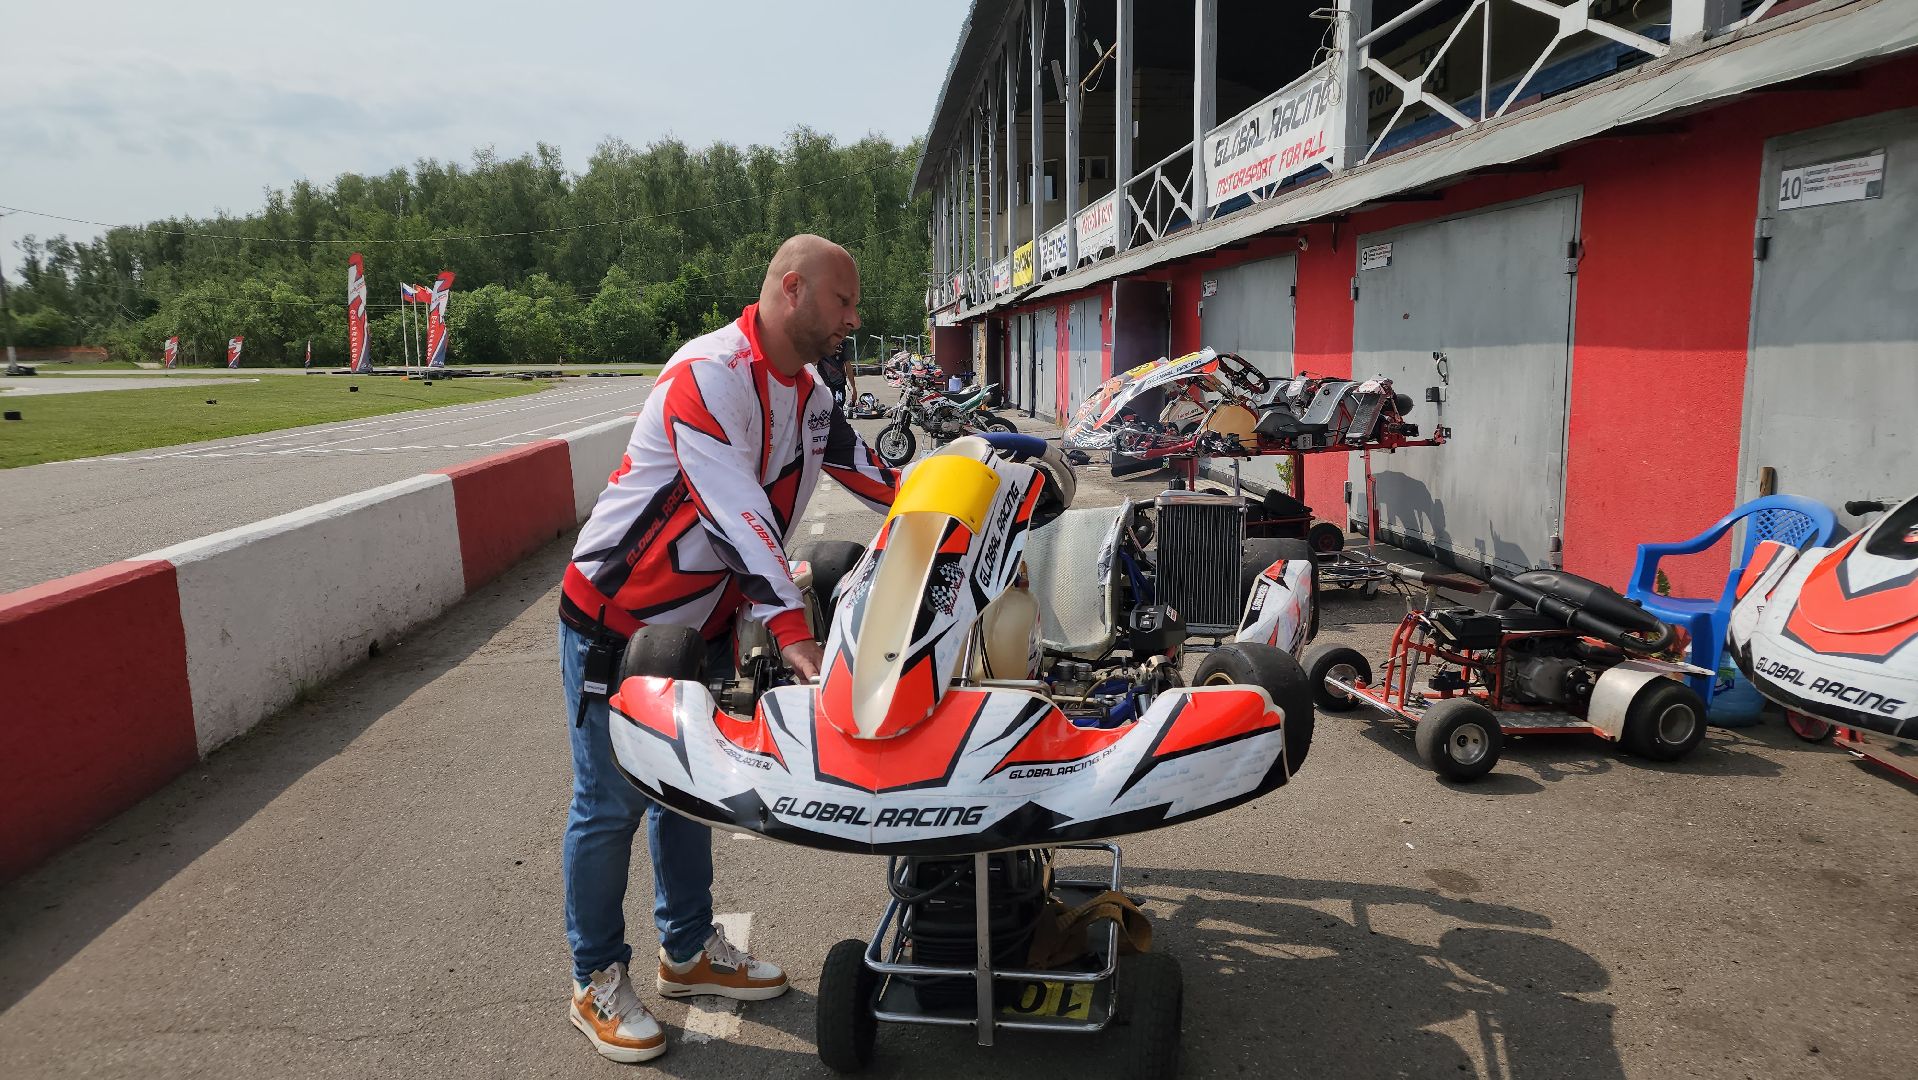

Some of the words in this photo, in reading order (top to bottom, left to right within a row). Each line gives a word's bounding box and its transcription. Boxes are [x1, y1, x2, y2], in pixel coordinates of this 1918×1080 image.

[1214, 117, 1266, 168] GLOBAL
[1268, 77, 1334, 142] RACING
[1216, 154, 1277, 197] MOTORSPORT
[1279, 142, 1302, 172] FOR
[1303, 131, 1327, 160] ALL
[1780, 176, 1802, 201] 10
[1362, 250, 1368, 265] 9
[625, 517, 667, 568] GLOBAL
[741, 511, 778, 553] GLOBAL
[980, 532, 1001, 588] GLOBAL
[996, 481, 1020, 536] RACING
[1755, 656, 1805, 687] GLOBAL
[1808, 676, 1907, 715] RACING
[771, 796, 872, 826] GLOBAL
[873, 805, 989, 828] RACING
